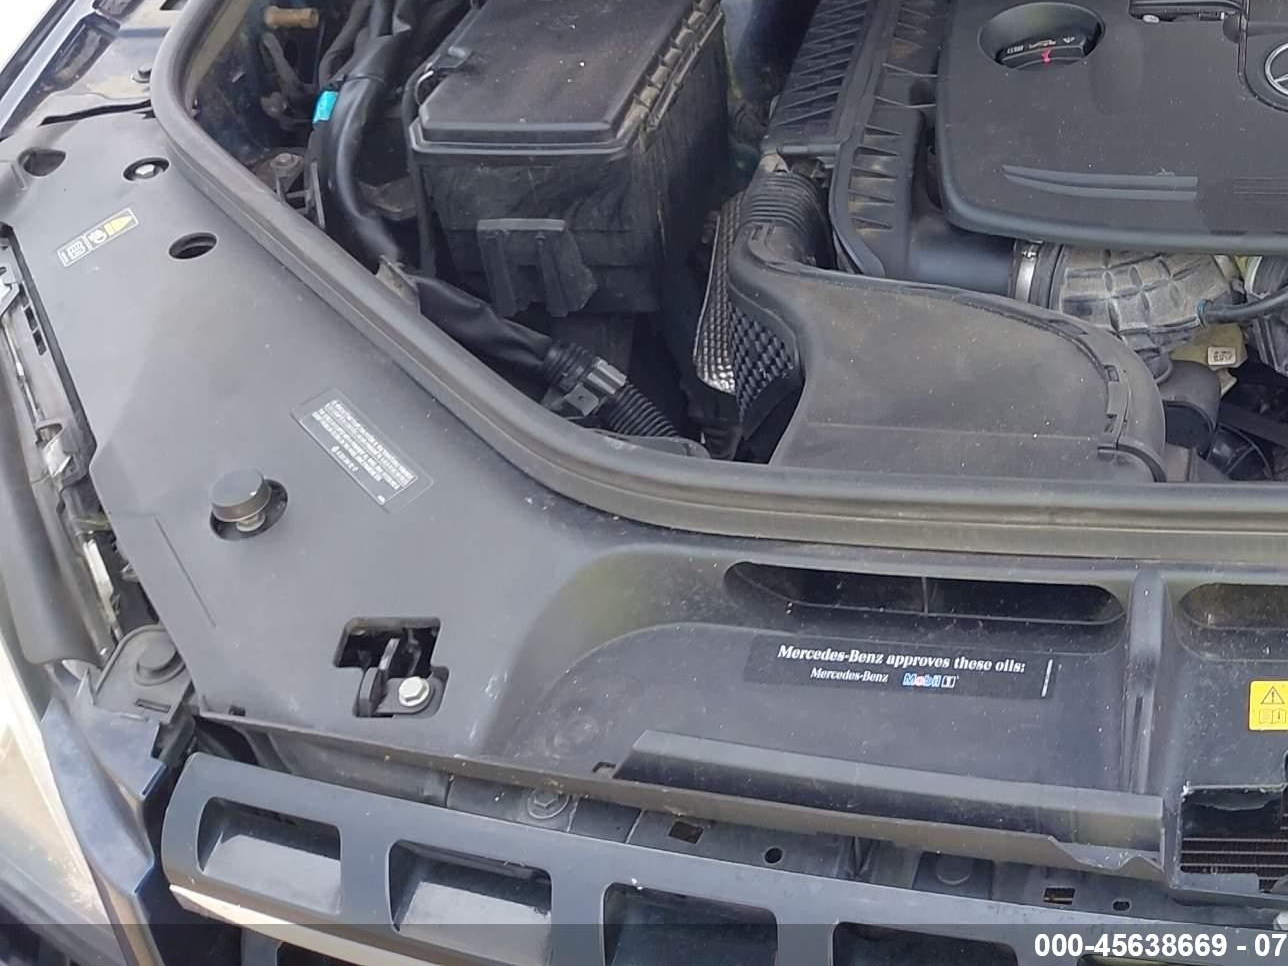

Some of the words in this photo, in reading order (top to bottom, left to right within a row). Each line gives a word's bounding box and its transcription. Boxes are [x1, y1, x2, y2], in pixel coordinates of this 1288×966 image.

[776, 644, 884, 664] Mercedes-Benz
[886, 653, 951, 668] approves
[953, 656, 993, 670] these
[994, 659, 1026, 673] oils:
[810, 666, 889, 683] Mercedes-Benz
